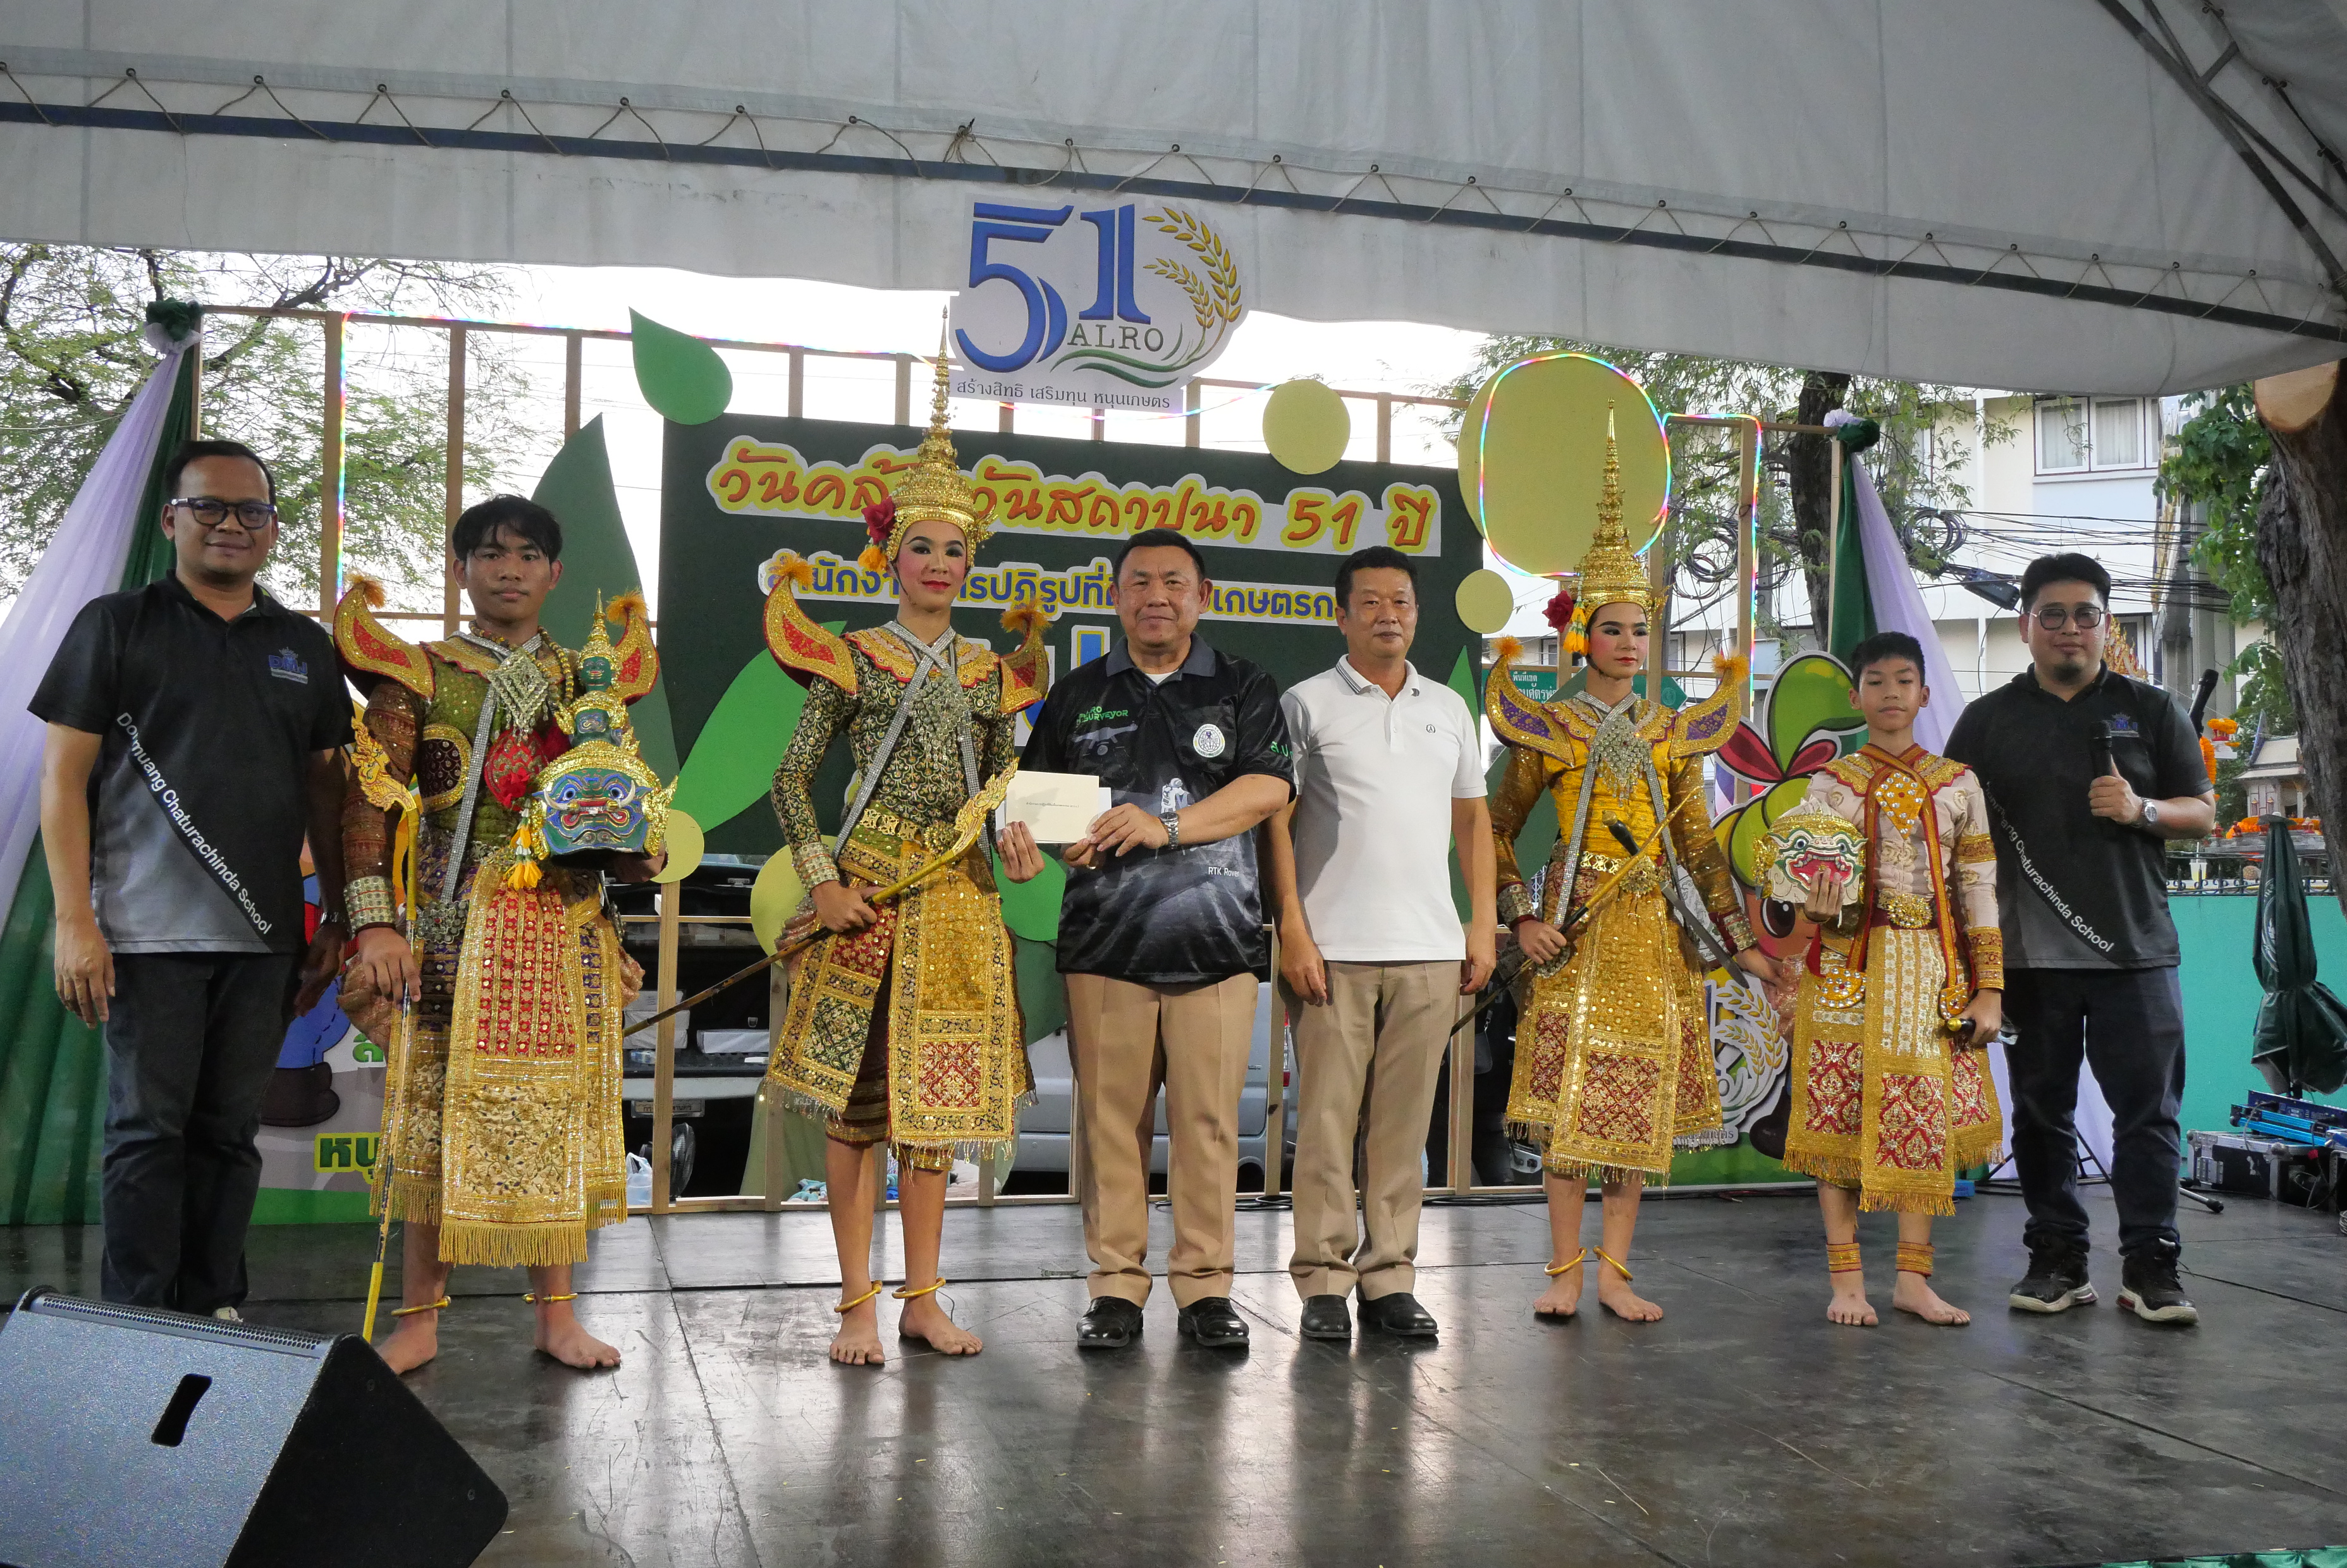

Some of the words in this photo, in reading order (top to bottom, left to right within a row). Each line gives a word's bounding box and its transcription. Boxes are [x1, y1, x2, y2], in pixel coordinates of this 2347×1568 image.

[955, 202, 1151, 373] 51
[1067, 324, 1164, 352] ALRO
[957, 378, 1023, 398] สร้างสิทธิ
[1031, 386, 1086, 407] เสริมทุน
[1094, 392, 1170, 408] หนุนเกษตร
[719, 447, 1256, 536] วันคล้วันสถาปนา
[1287, 498, 1358, 544] 51
[1394, 493, 1431, 546] ปี
[163, 790, 240, 891] Chaturachinda
[239, 888, 273, 934] School
[1208, 866, 1222, 876] RTK
[1224, 867, 1239, 878] Rover
[2016, 840, 2073, 919] Chaturachinda
[2071, 916, 2115, 952] School
